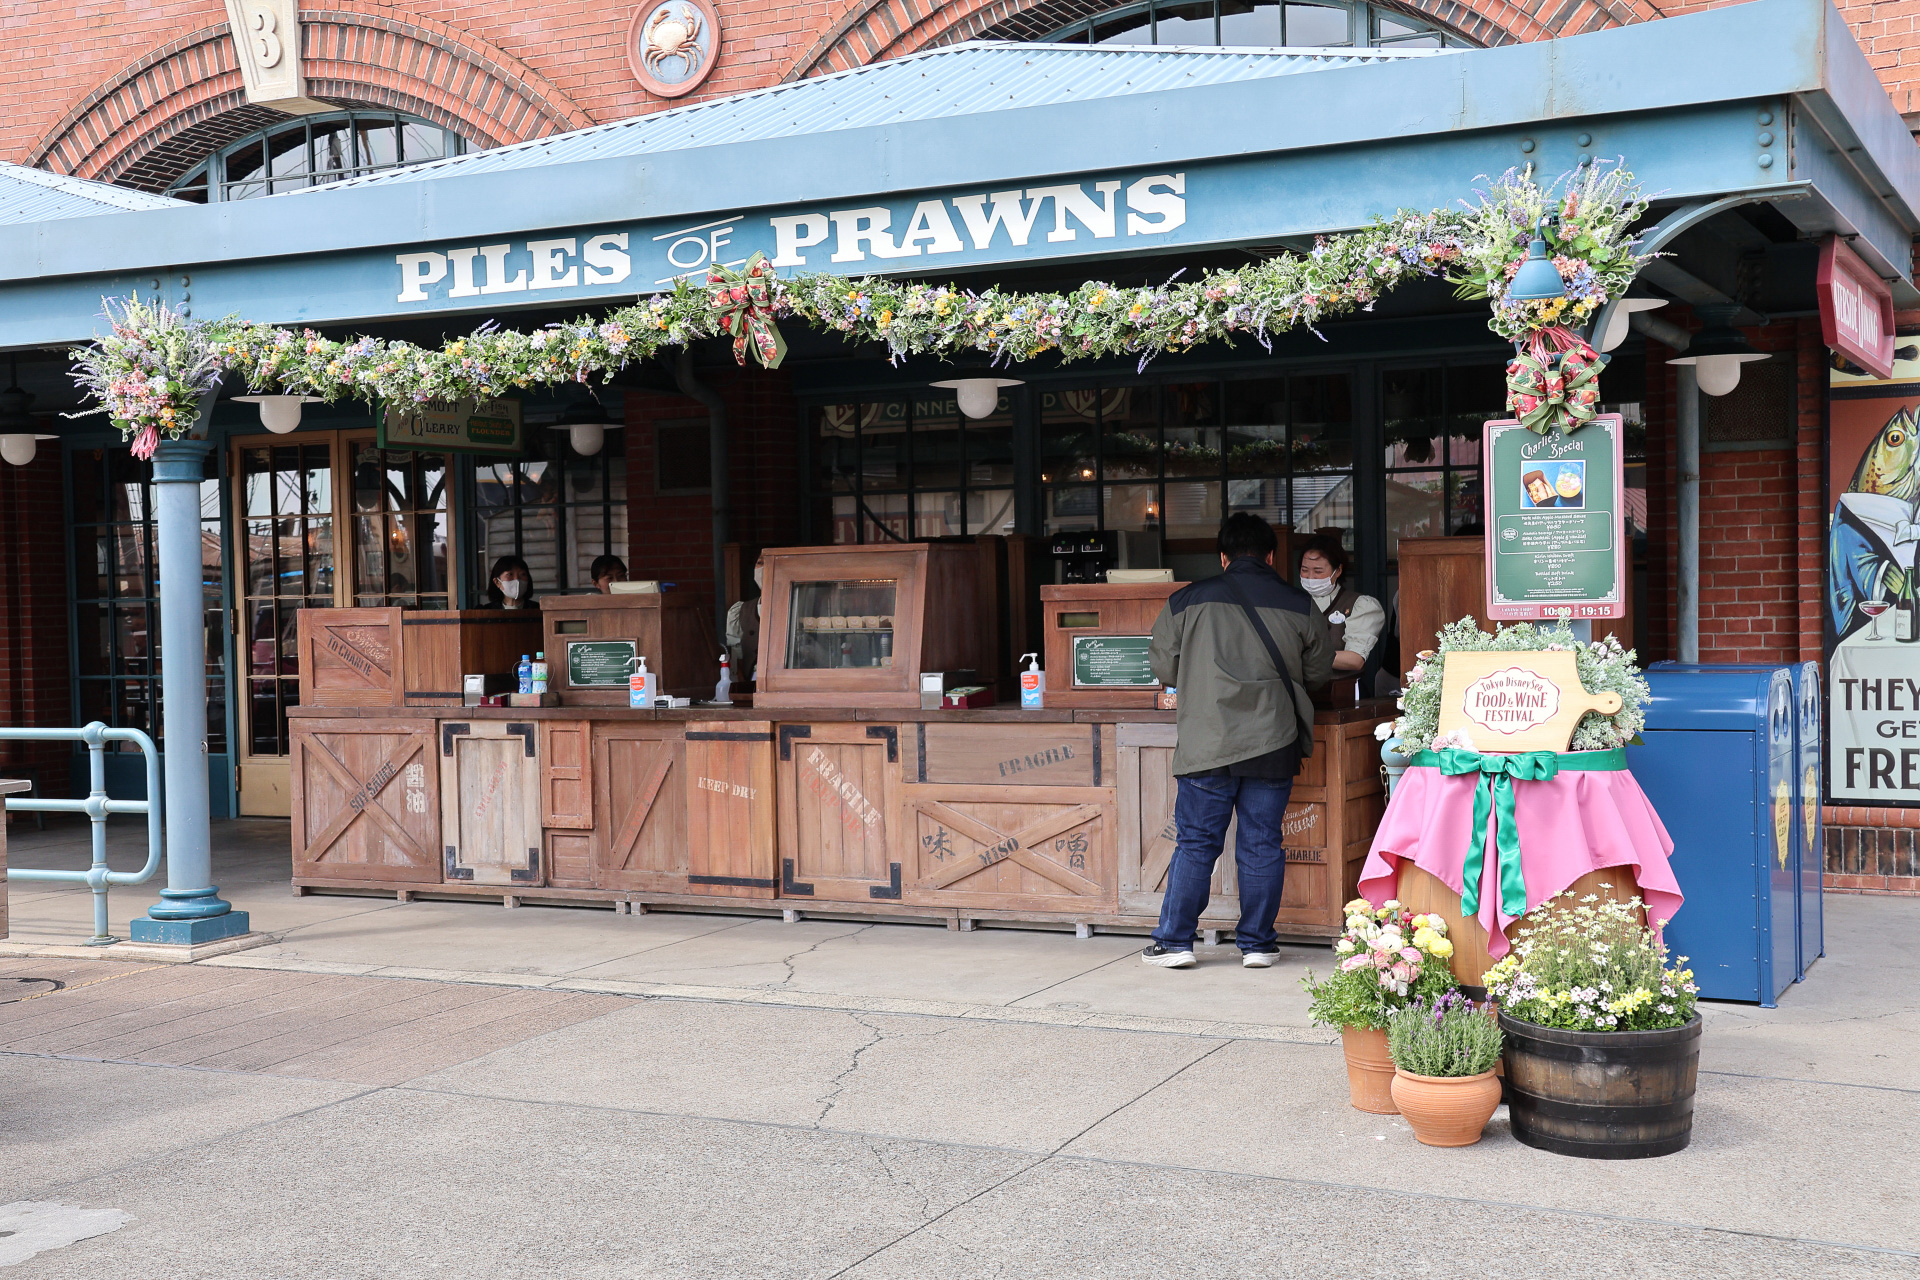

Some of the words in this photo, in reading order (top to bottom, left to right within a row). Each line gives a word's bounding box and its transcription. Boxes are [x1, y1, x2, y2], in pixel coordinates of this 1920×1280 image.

[250, 5, 283, 69] 3
[396, 232, 631, 302] PILES
[667, 225, 734, 268] OF
[770, 172, 1187, 267] PRAWNS
[1833, 279, 1858, 333] ATERSIDE
[1858, 284, 1878, 349] DINING
[1521, 431, 1560, 459] Charlie's
[1548, 440, 1584, 459] Special
[1581, 606, 1611, 616] 19:15
[327, 635, 339, 652] TO
[338, 643, 373, 677] CHARLIE
[1475, 692, 1506, 707] FOOD
[1507, 697, 1513, 707] &
[1515, 692, 1548, 707] WINE
[1480, 679, 1504, 692] Tokyo
[1506, 676, 1543, 692] DisneySea
[1839, 678, 1920, 711] THEY
[1485, 710, 1534, 722] FESTIVAL
[1876, 720, 1920, 738] GE
[998, 744, 1075, 777] FRAGILE
[350, 790, 369, 814] SOY
[365, 760, 397, 797] SAUCE
[697, 777, 729, 793] KEEP
[732, 784, 757, 800] DRY
[800, 767, 841, 808] KEEP
[807, 746, 882, 827] FRAGILE
[922, 826, 955, 862] 味
[1055, 832, 1088, 870] 噌
[978, 837, 1019, 866] MISO
